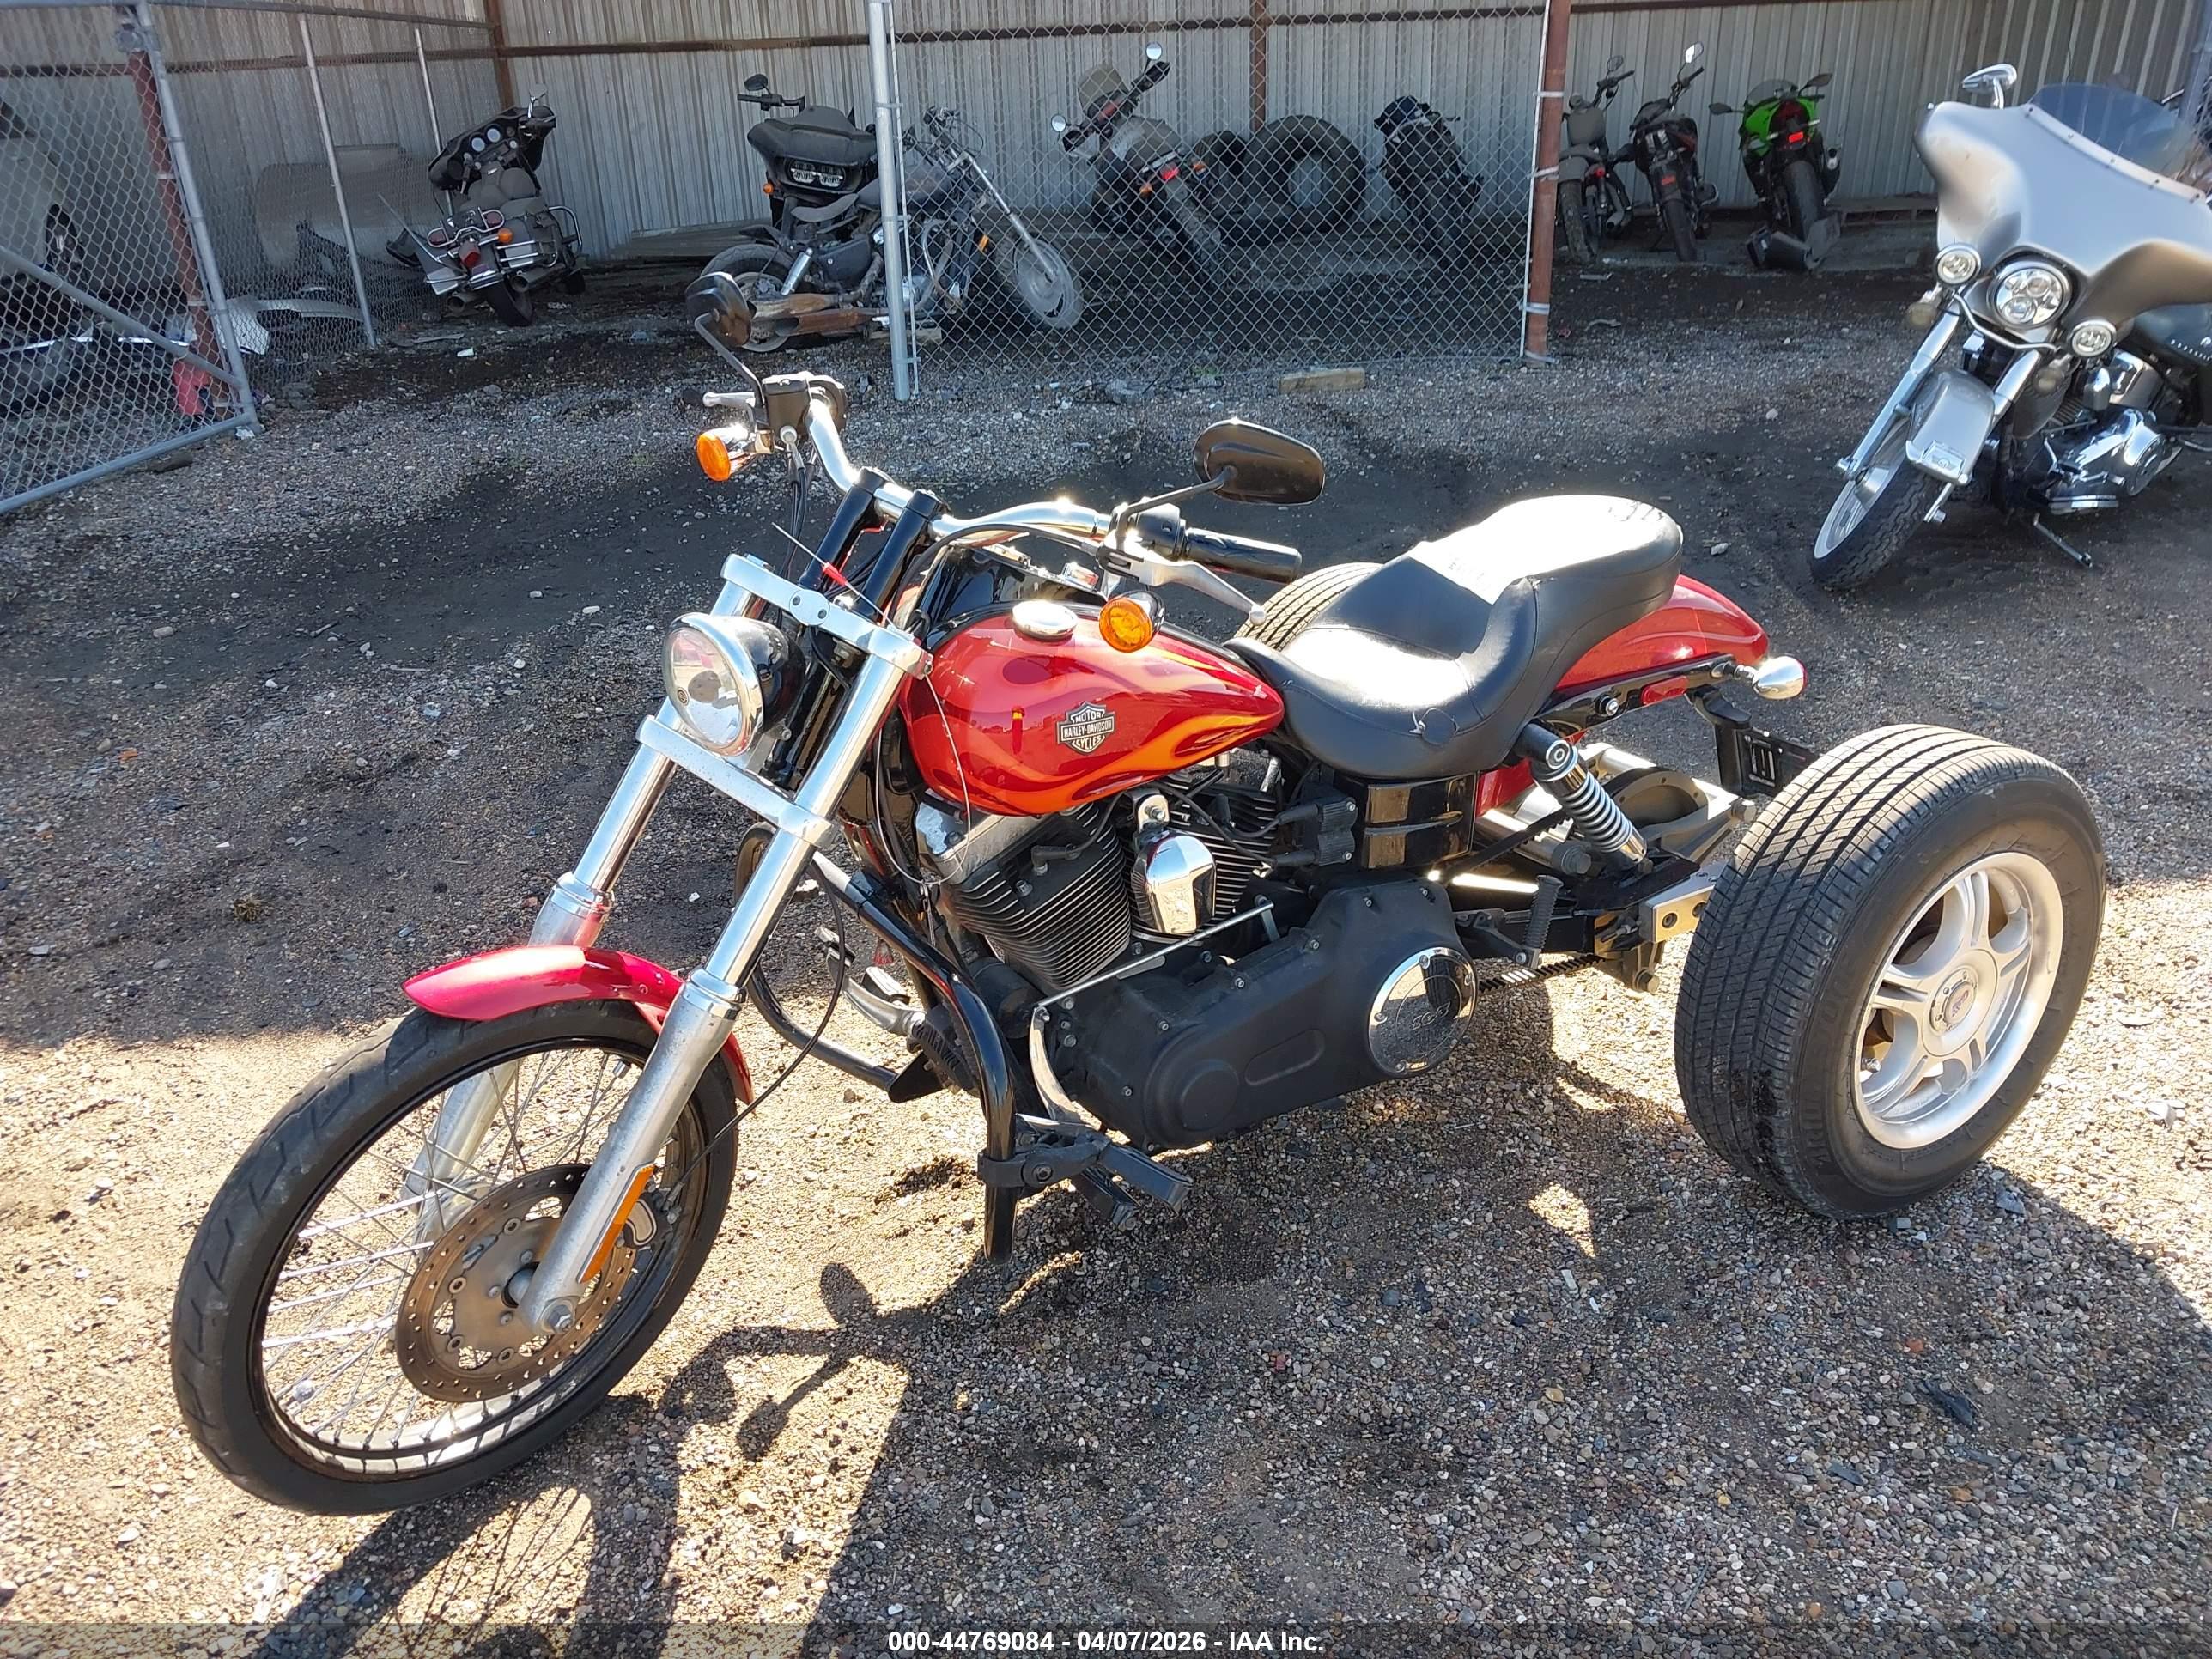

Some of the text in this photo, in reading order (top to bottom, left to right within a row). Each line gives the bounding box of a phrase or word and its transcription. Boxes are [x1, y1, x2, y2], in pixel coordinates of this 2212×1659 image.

[1075, 710, 1101, 723] MOTOR
[1064, 720, 1112, 738] HARLEY-DAVIDSON
[1076, 735, 1102, 750] CYCLES
